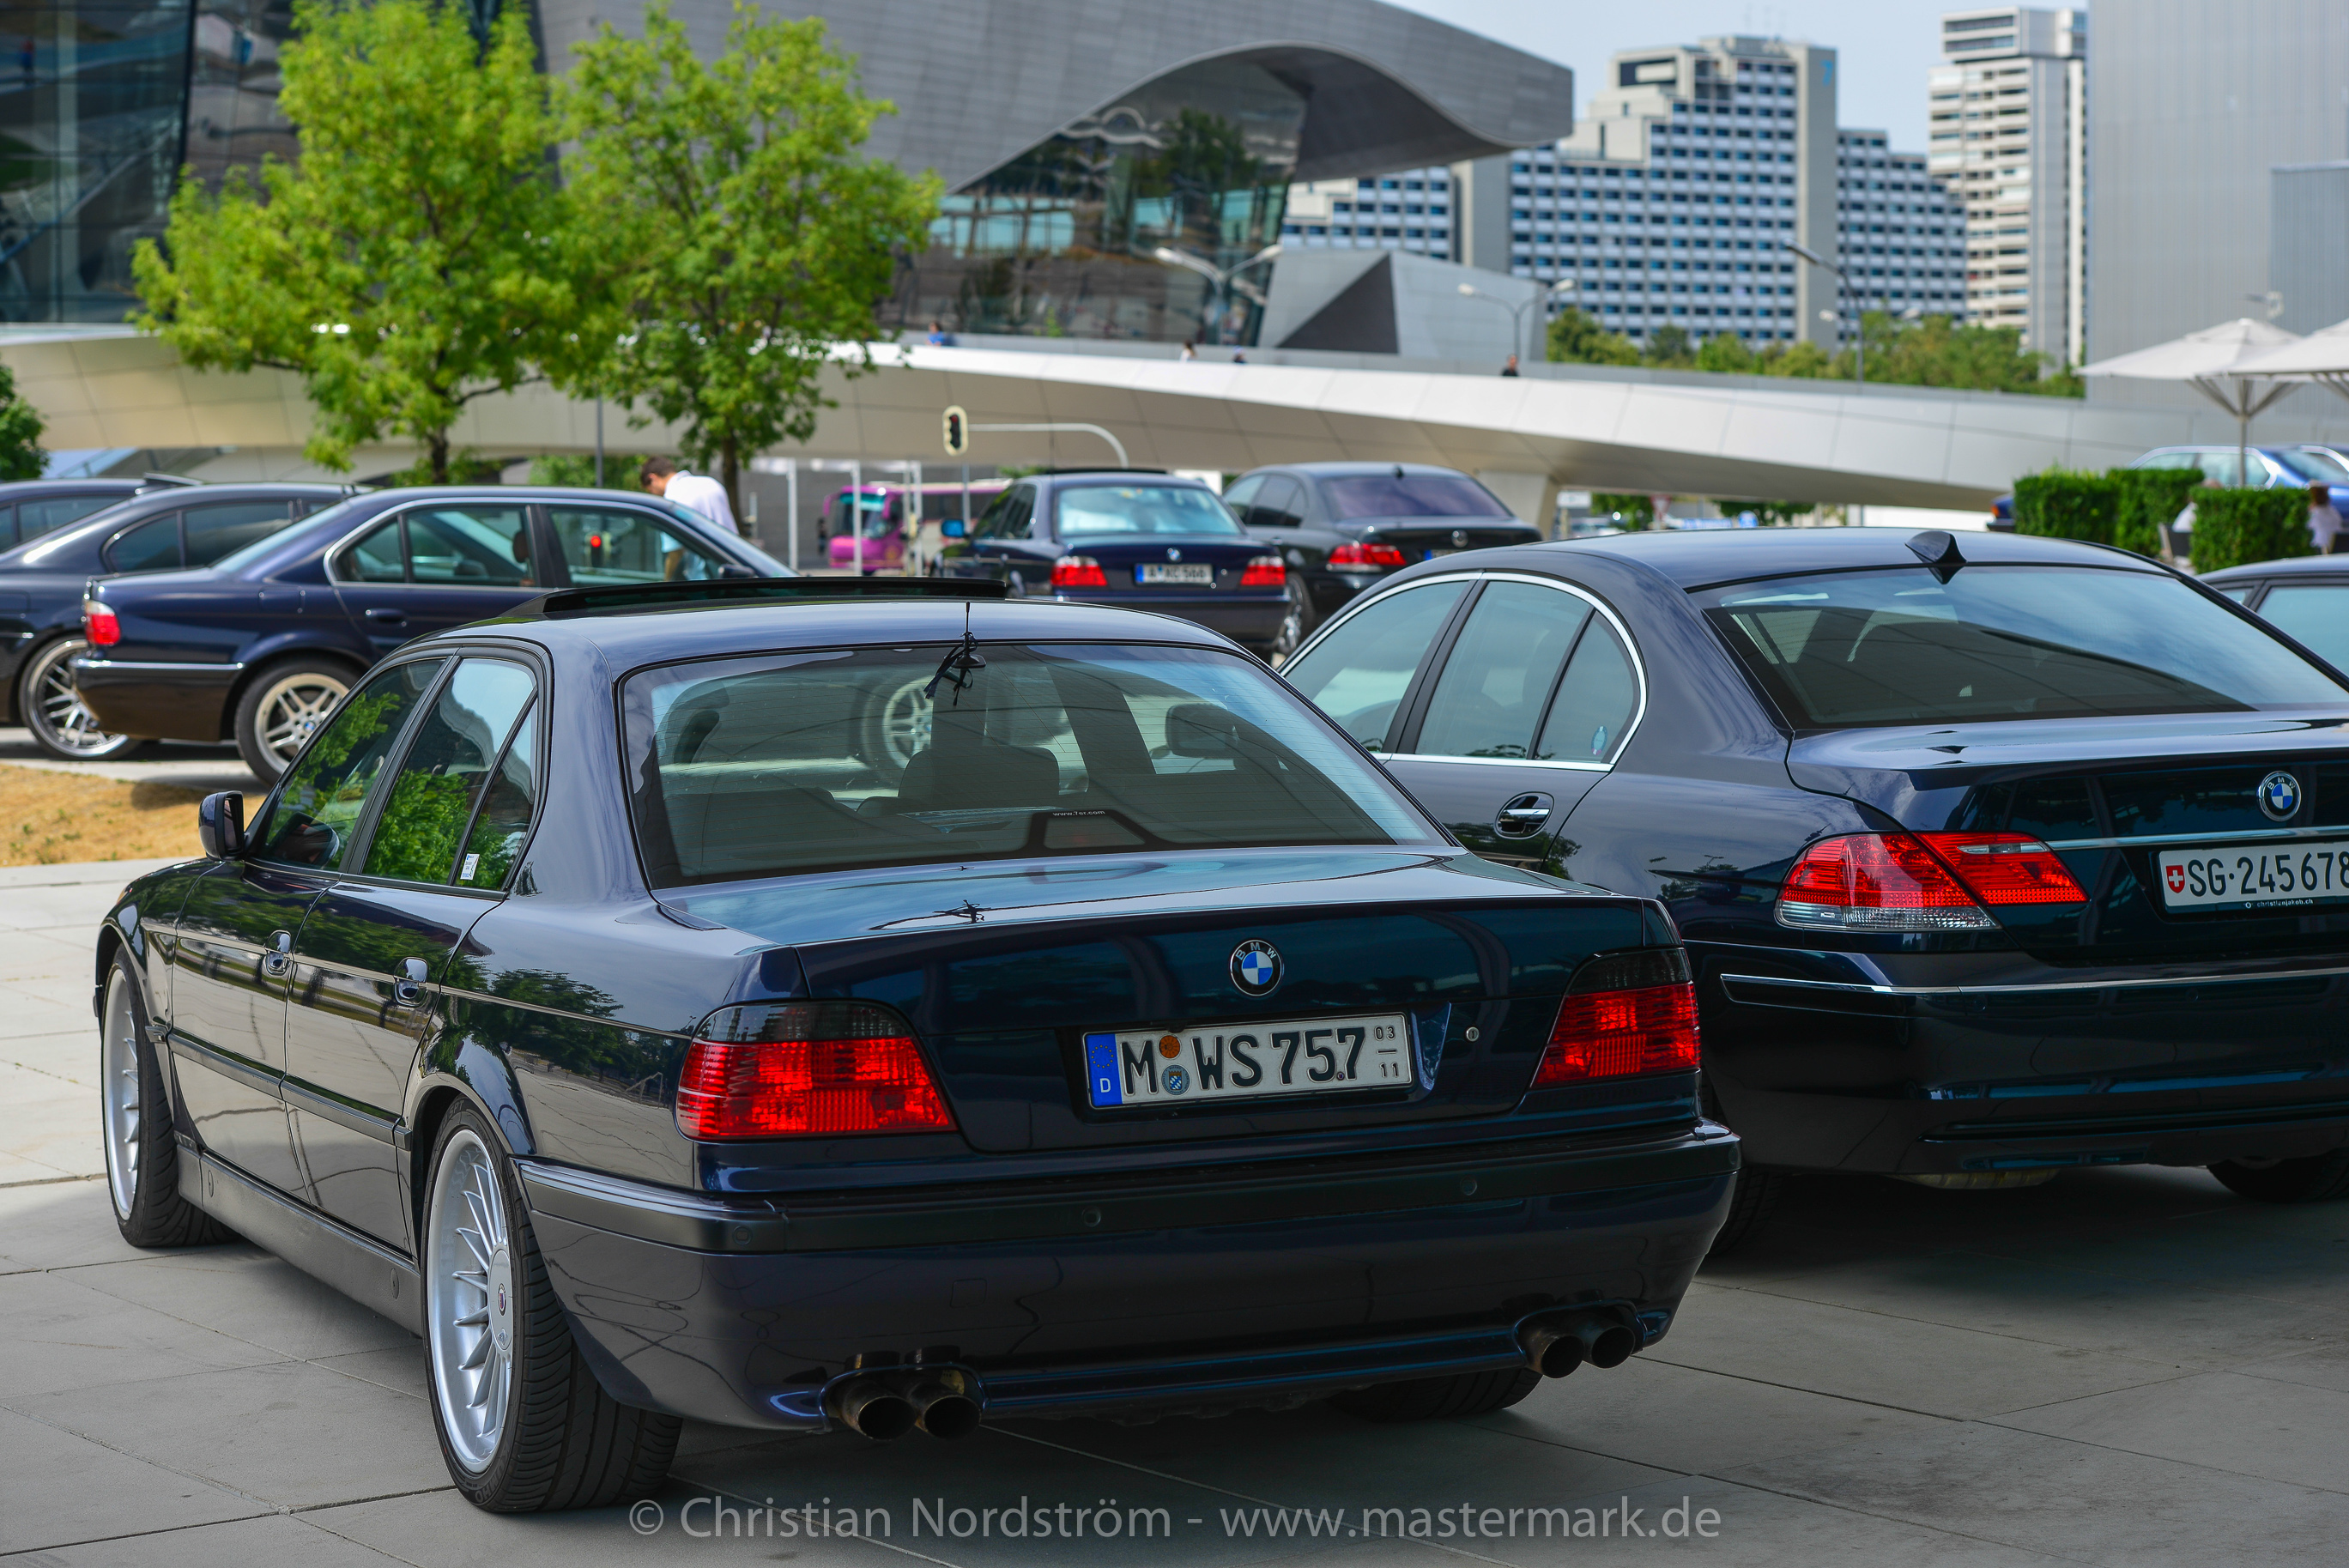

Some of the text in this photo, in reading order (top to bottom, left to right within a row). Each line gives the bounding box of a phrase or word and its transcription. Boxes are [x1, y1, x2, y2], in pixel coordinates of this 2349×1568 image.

[2267, 777, 2296, 790] BMW
[1236, 942, 1276, 960] BMW
[1374, 1026, 1395, 1041] 03
[1379, 1063, 1398, 1078] 11
[1099, 1077, 1111, 1093] D
